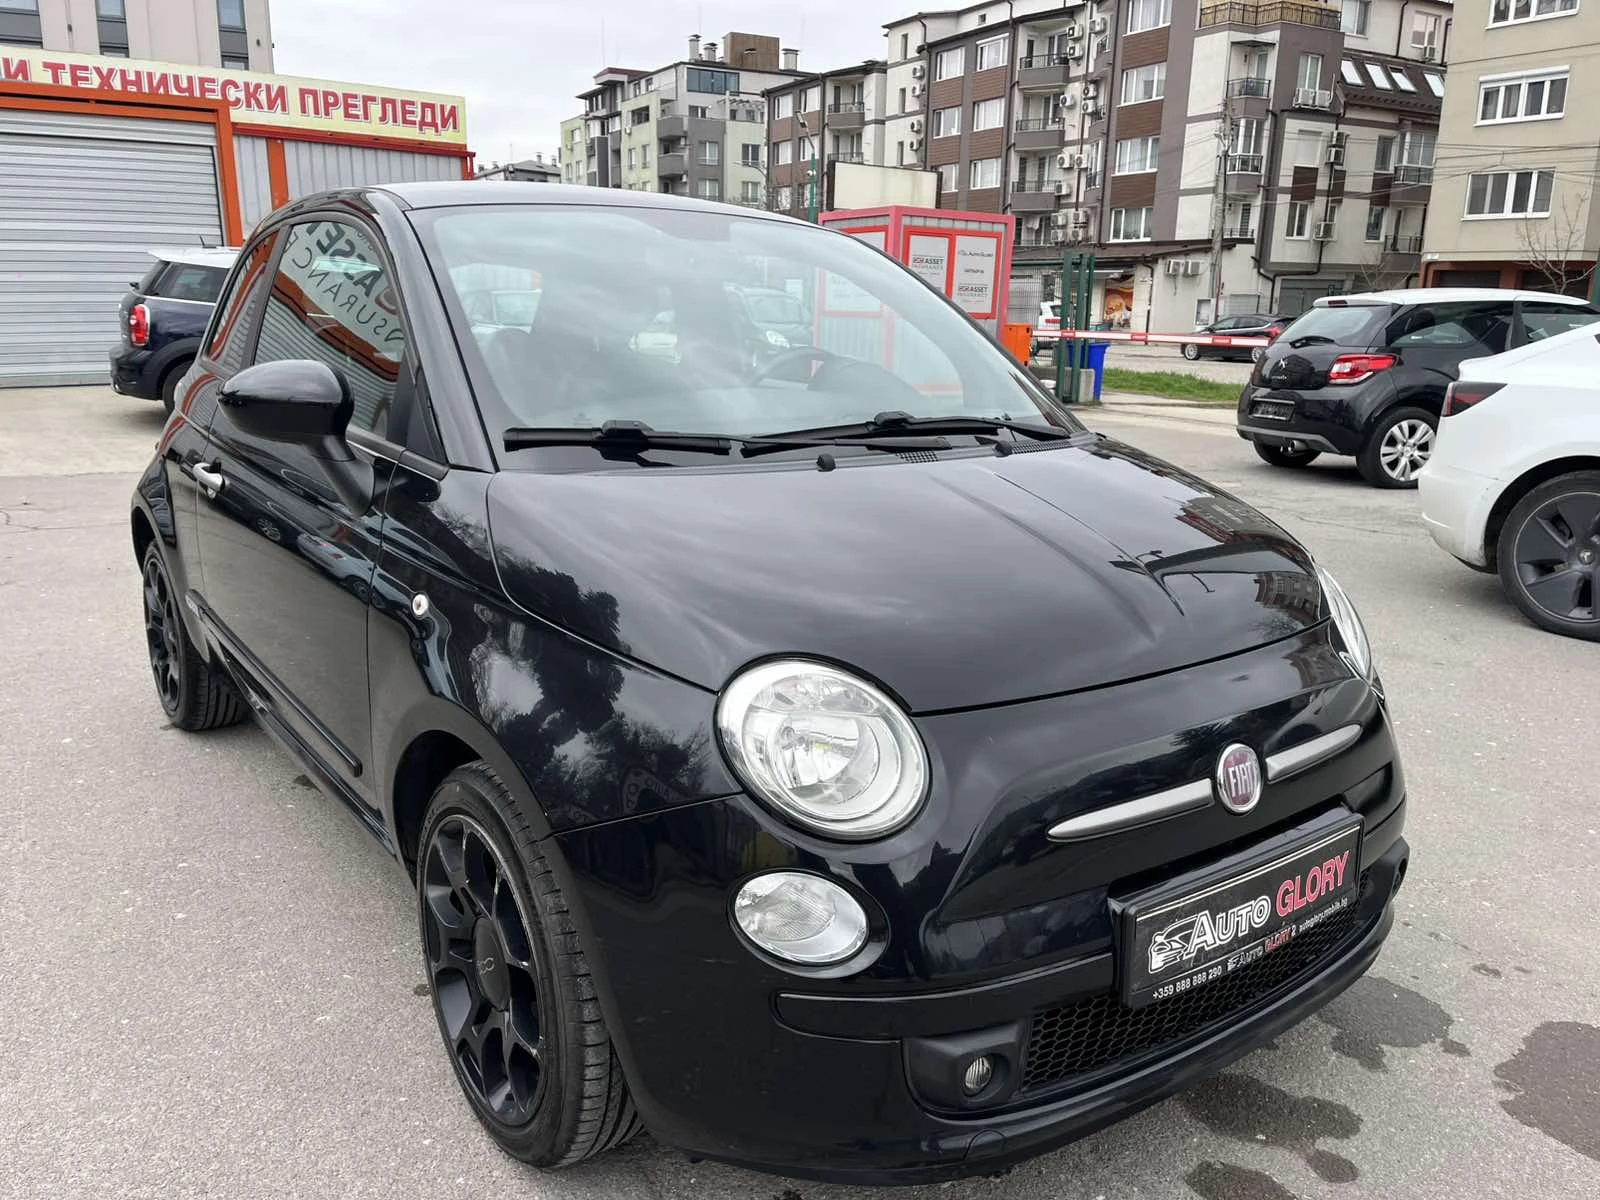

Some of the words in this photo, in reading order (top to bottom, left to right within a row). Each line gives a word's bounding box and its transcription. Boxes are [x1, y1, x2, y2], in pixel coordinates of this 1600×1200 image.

[42, 61, 288, 113] ТЕХНИЧЕСКИ
[298, 87, 459, 134] ПРЕГЛЕДИ
[1228, 762, 1253, 797] FIAT
[1183, 895, 1271, 960] AUTO
[1276, 850, 1349, 916] GLORY
[1153, 984, 1174, 999] +359
[1176, 978, 1191, 992] 888
[1192, 971, 1207, 985] 888
[1208, 965, 1222, 979] 290
[1264, 927, 1291, 953] GLORY
[1291, 924, 1297, 937] 2
